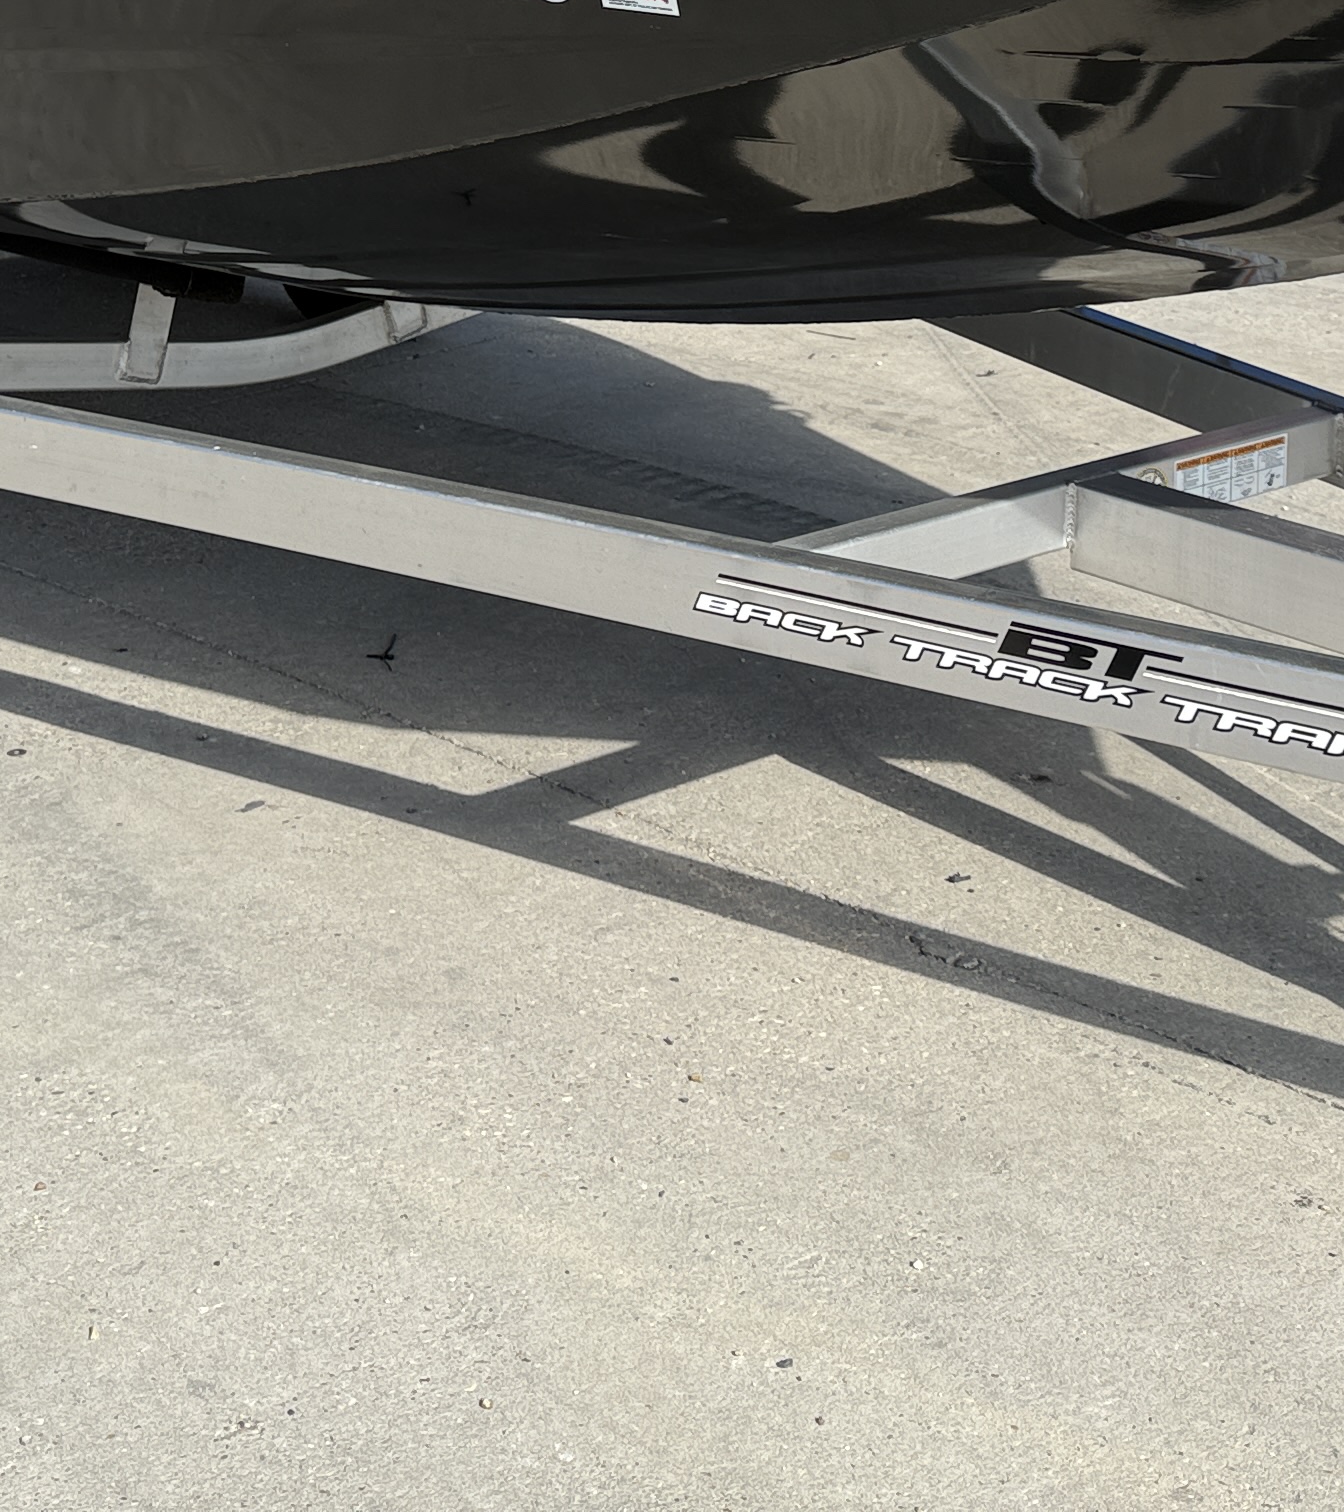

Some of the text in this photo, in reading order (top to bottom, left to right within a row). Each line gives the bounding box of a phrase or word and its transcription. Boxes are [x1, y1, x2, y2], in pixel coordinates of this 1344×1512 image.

[693, 591, 884, 648] BACK
[889, 635, 1154, 708] TRACK
[997, 621, 1176, 682] BT
